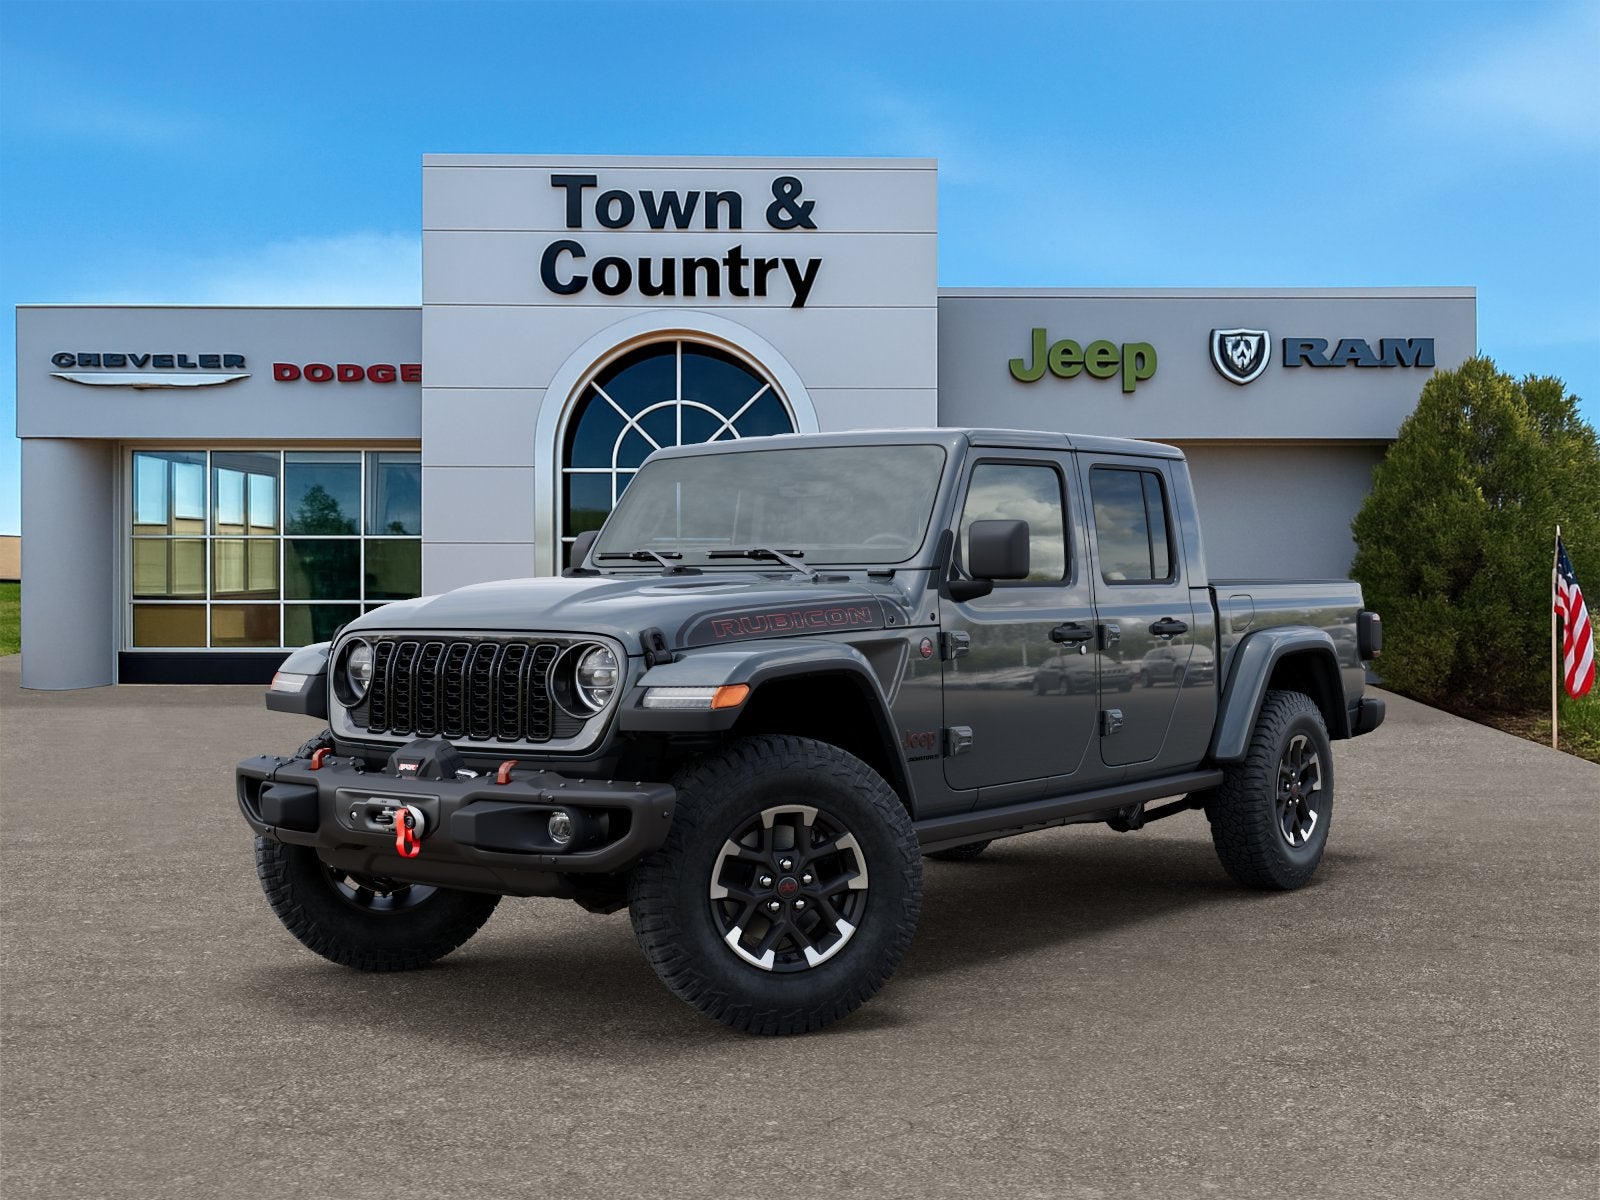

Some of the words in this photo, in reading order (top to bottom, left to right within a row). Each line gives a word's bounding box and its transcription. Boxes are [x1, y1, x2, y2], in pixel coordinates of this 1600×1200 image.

[550, 174, 743, 230] Town
[765, 176, 818, 230] &
[540, 239, 823, 308] Country
[273, 363, 422, 383] DODGE
[1008, 328, 1157, 392] Jeep
[1282, 337, 1435, 368] RAM
[711, 606, 873, 638] RUBICON
